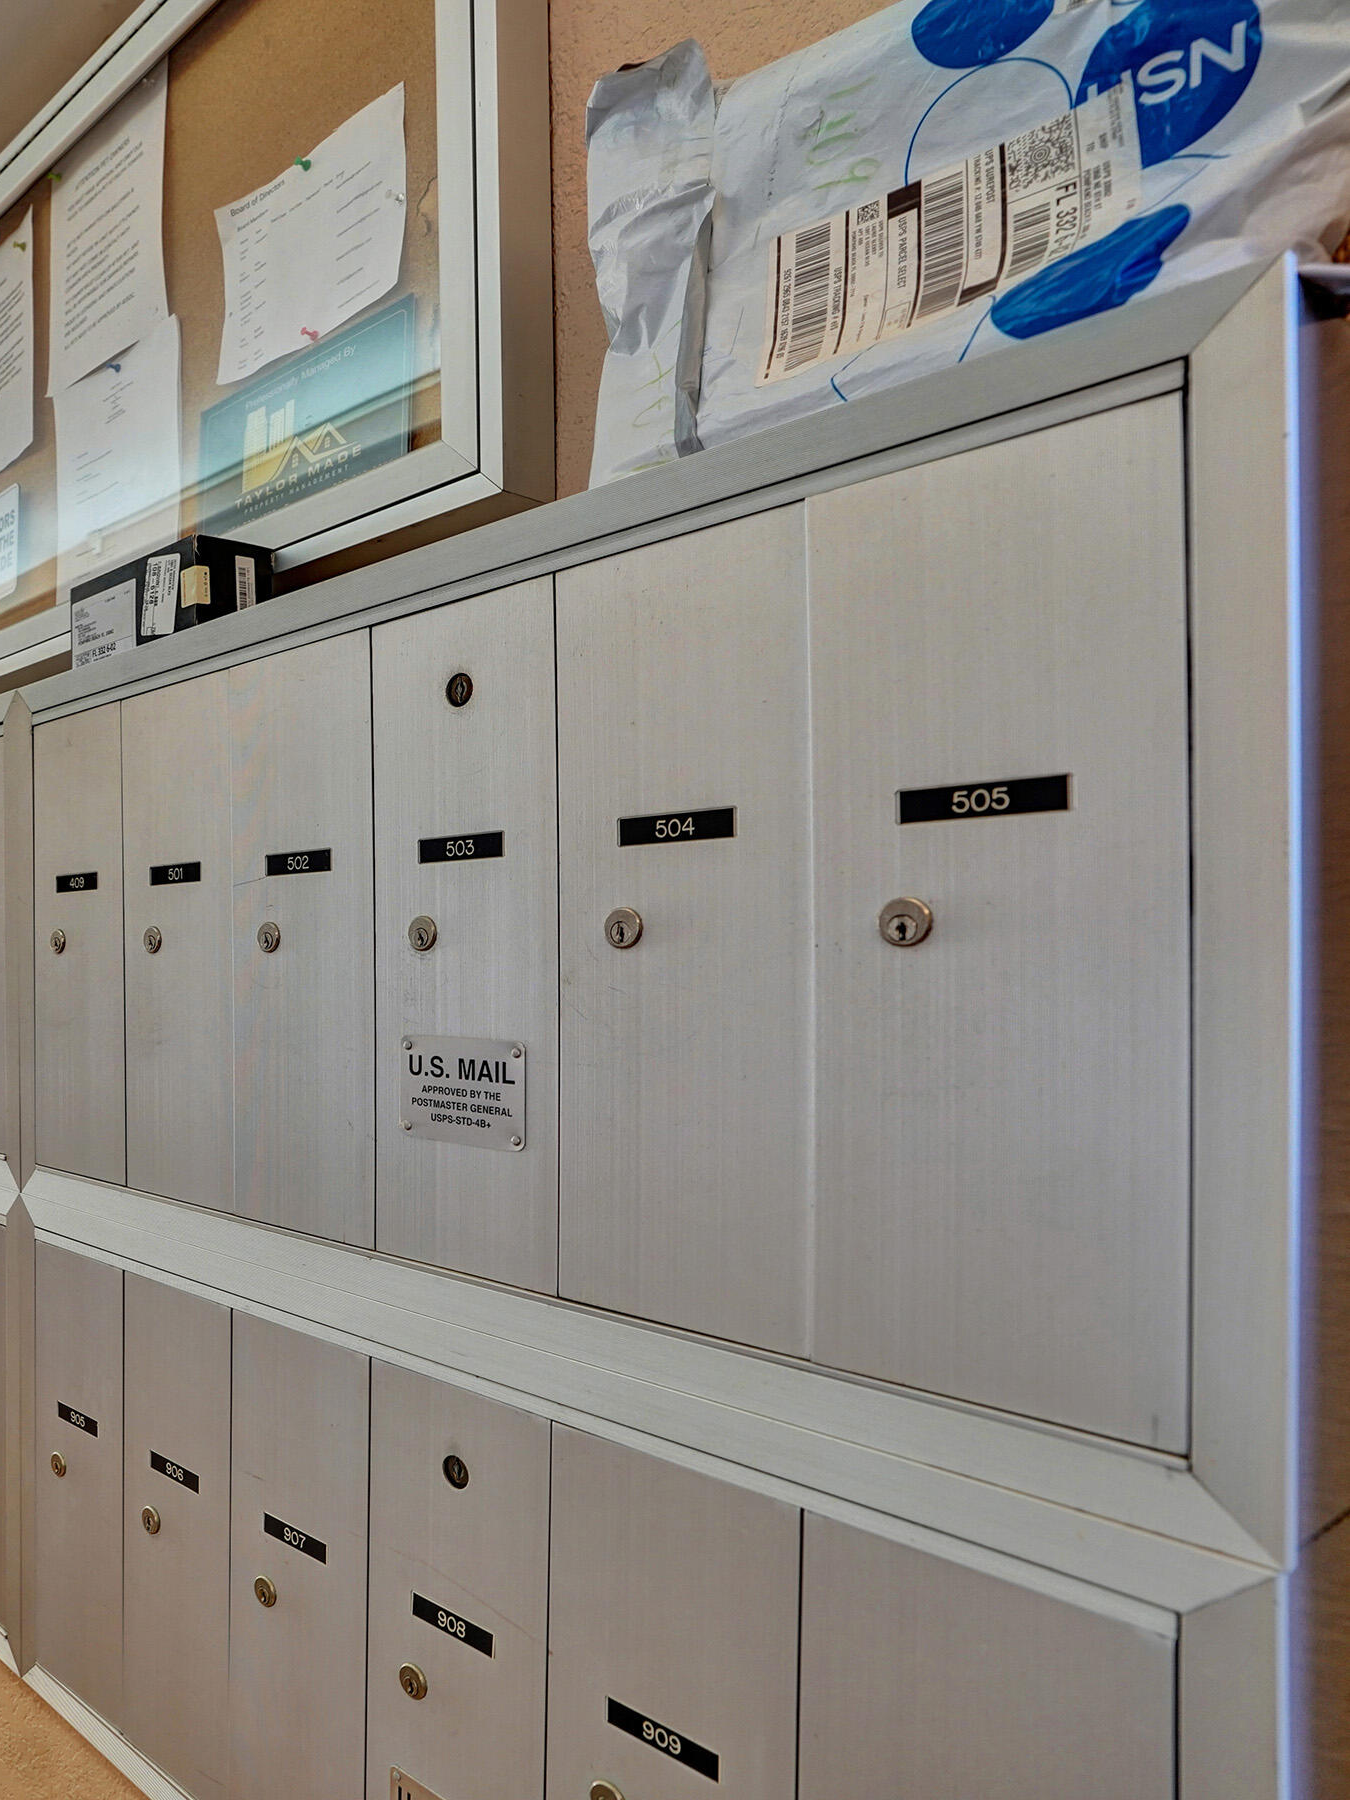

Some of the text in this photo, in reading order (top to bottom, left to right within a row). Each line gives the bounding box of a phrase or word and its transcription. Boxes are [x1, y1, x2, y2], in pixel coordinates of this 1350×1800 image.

[230, 180, 286, 217] Board of Directors
[1055, 182, 1077, 206] FL
[897, 216, 907, 289] USPS PARCEL SELECT
[833, 266, 842, 283] USPS
[831, 284, 841, 312] TRACKING
[301, 352, 342, 380] Managed
[343, 345, 356, 359] By
[235, 444, 362, 509] TAYLOR MADE
[0, 530, 15, 553] THE
[951, 788, 1011, 813] 505
[654, 817, 696, 838] 504
[445, 838, 476, 857] 503
[287, 855, 310, 871] 502
[69, 877, 85, 889] 409
[167, 868, 184, 880] 501
[409, 1054, 516, 1085] U.S. MAIL
[421, 1085, 501, 1101] APPROVED BY THE
[411, 1097, 513, 1117] POSTMASTER GENERAL
[431, 1113, 491, 1129] USPS-STD-4B+
[70, 1411, 86, 1428] 905
[165, 1462, 184, 1481] 906
[283, 1527, 306, 1548] 907
[437, 1610, 467, 1639] 908
[642, 1720, 682, 1755] 909
